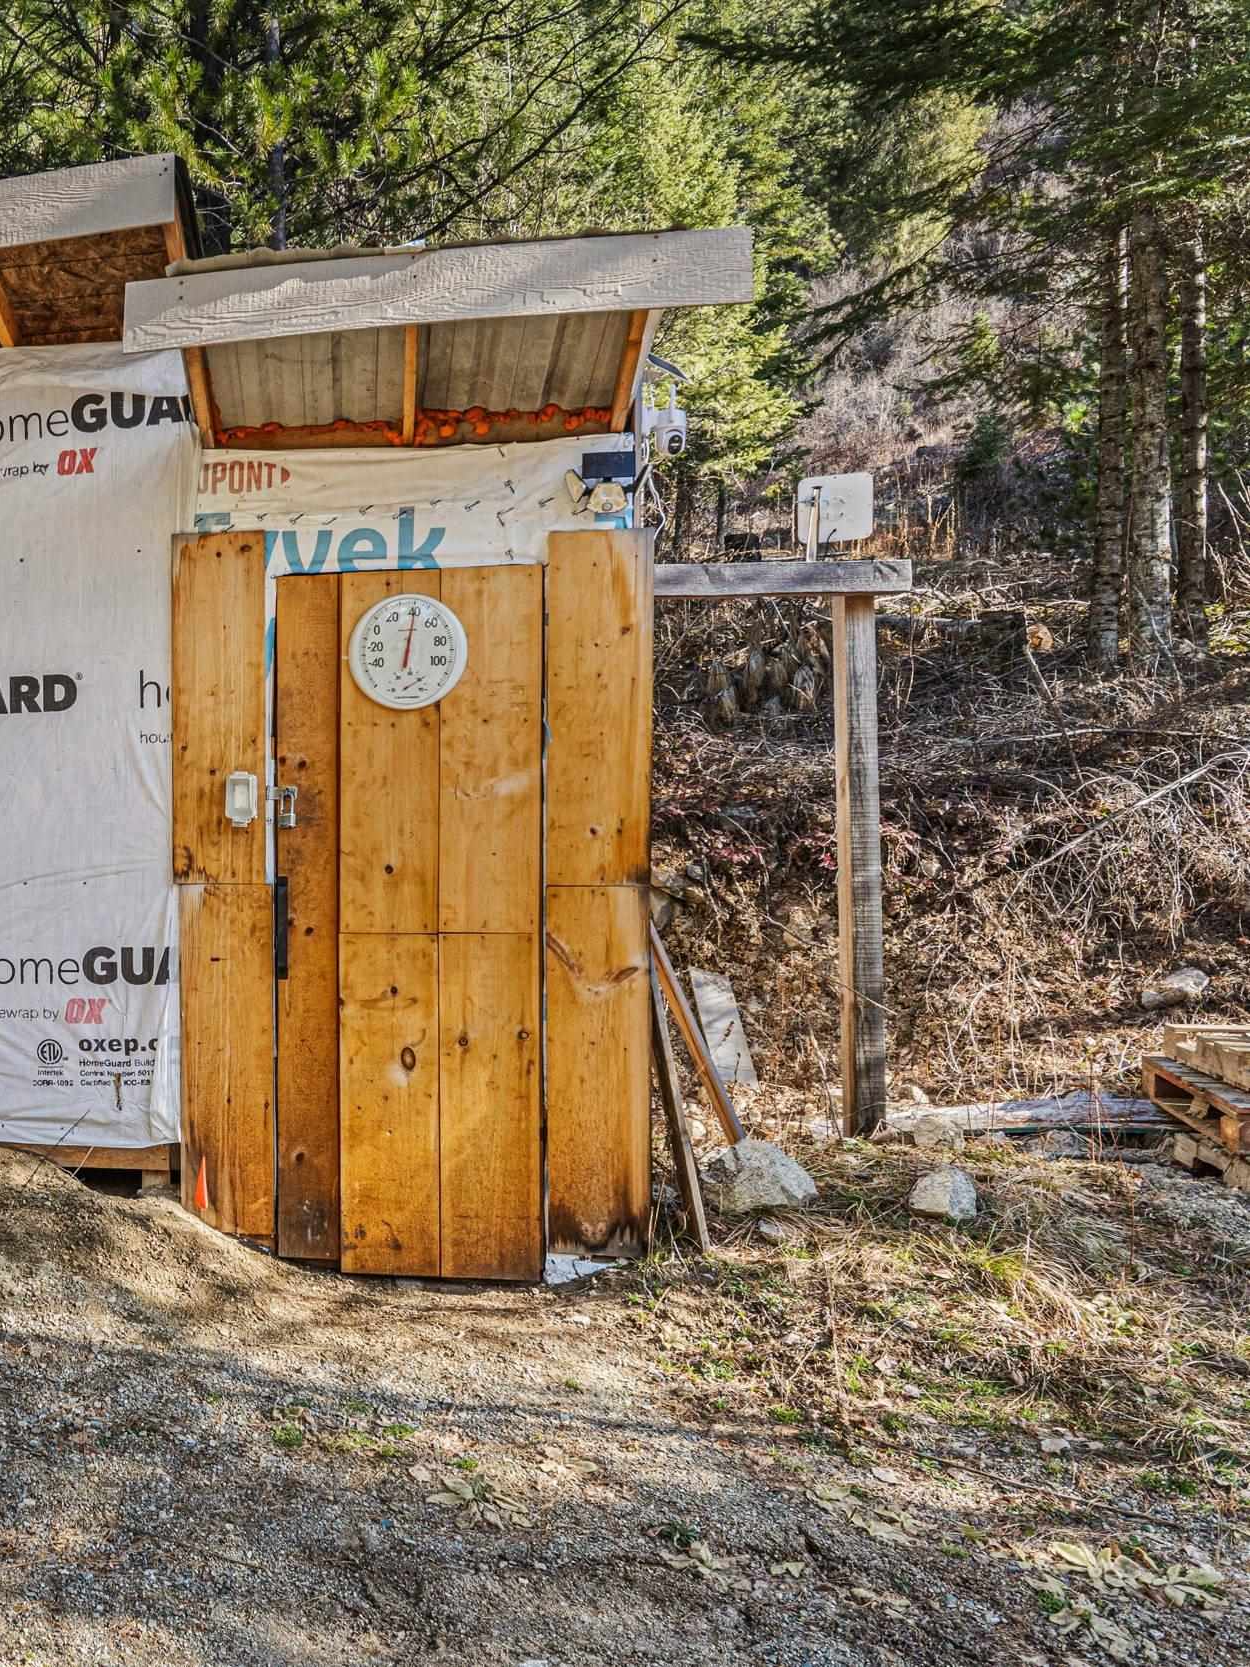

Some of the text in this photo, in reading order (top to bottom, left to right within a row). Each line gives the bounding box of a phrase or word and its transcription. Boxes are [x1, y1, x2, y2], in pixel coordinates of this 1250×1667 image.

[57, 447, 98, 476] OX
[194, 506, 446, 575] vek
[386, 612, 399, 622] 20
[424, 617, 438, 628] 60
[373, 625, 381, 635] 0
[433, 636, 447, 646] 80
[430, 655, 447, 666] 100
[43, 1006, 59, 1022] by
[64, 997, 107, 1025] OX
